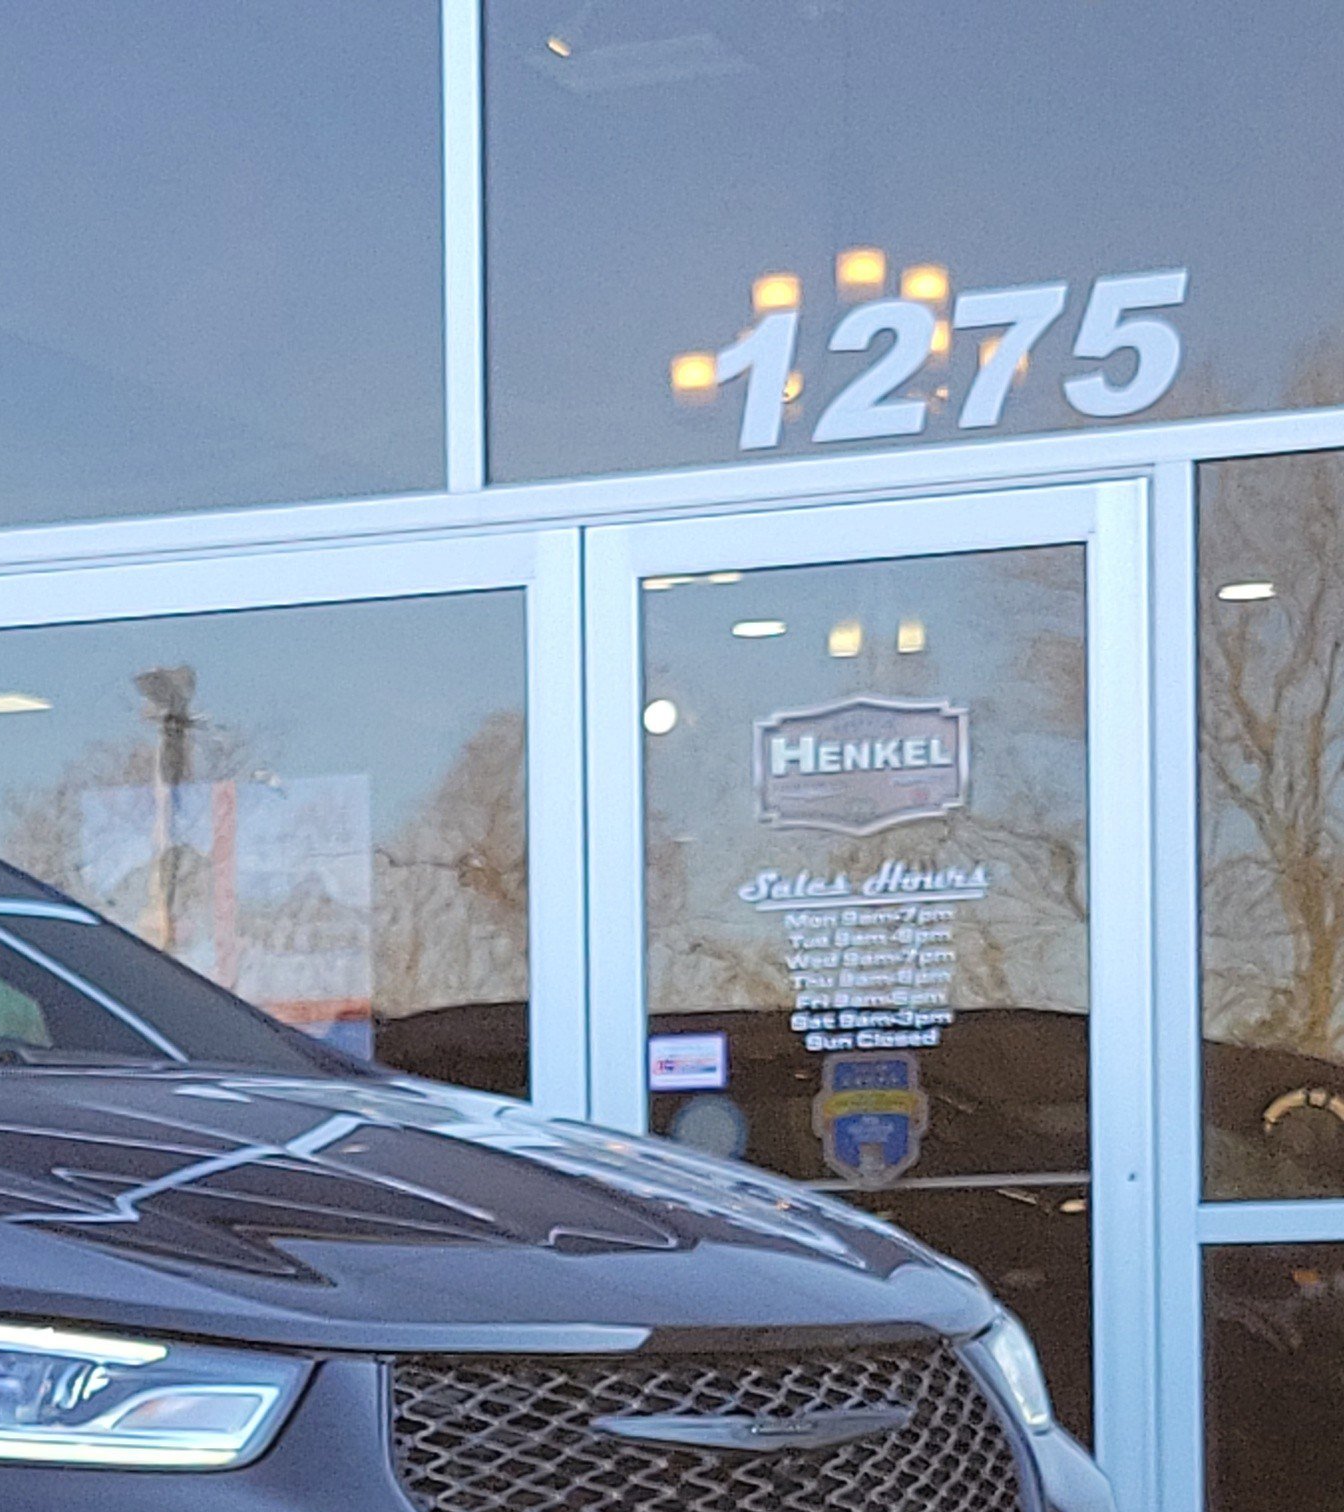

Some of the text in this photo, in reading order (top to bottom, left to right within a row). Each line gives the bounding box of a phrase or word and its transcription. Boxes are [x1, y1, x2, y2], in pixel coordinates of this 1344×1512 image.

[716, 267, 1188, 452] 1275
[771, 735, 953, 776] HENKEL
[739, 858, 989, 902] Sales Hours
